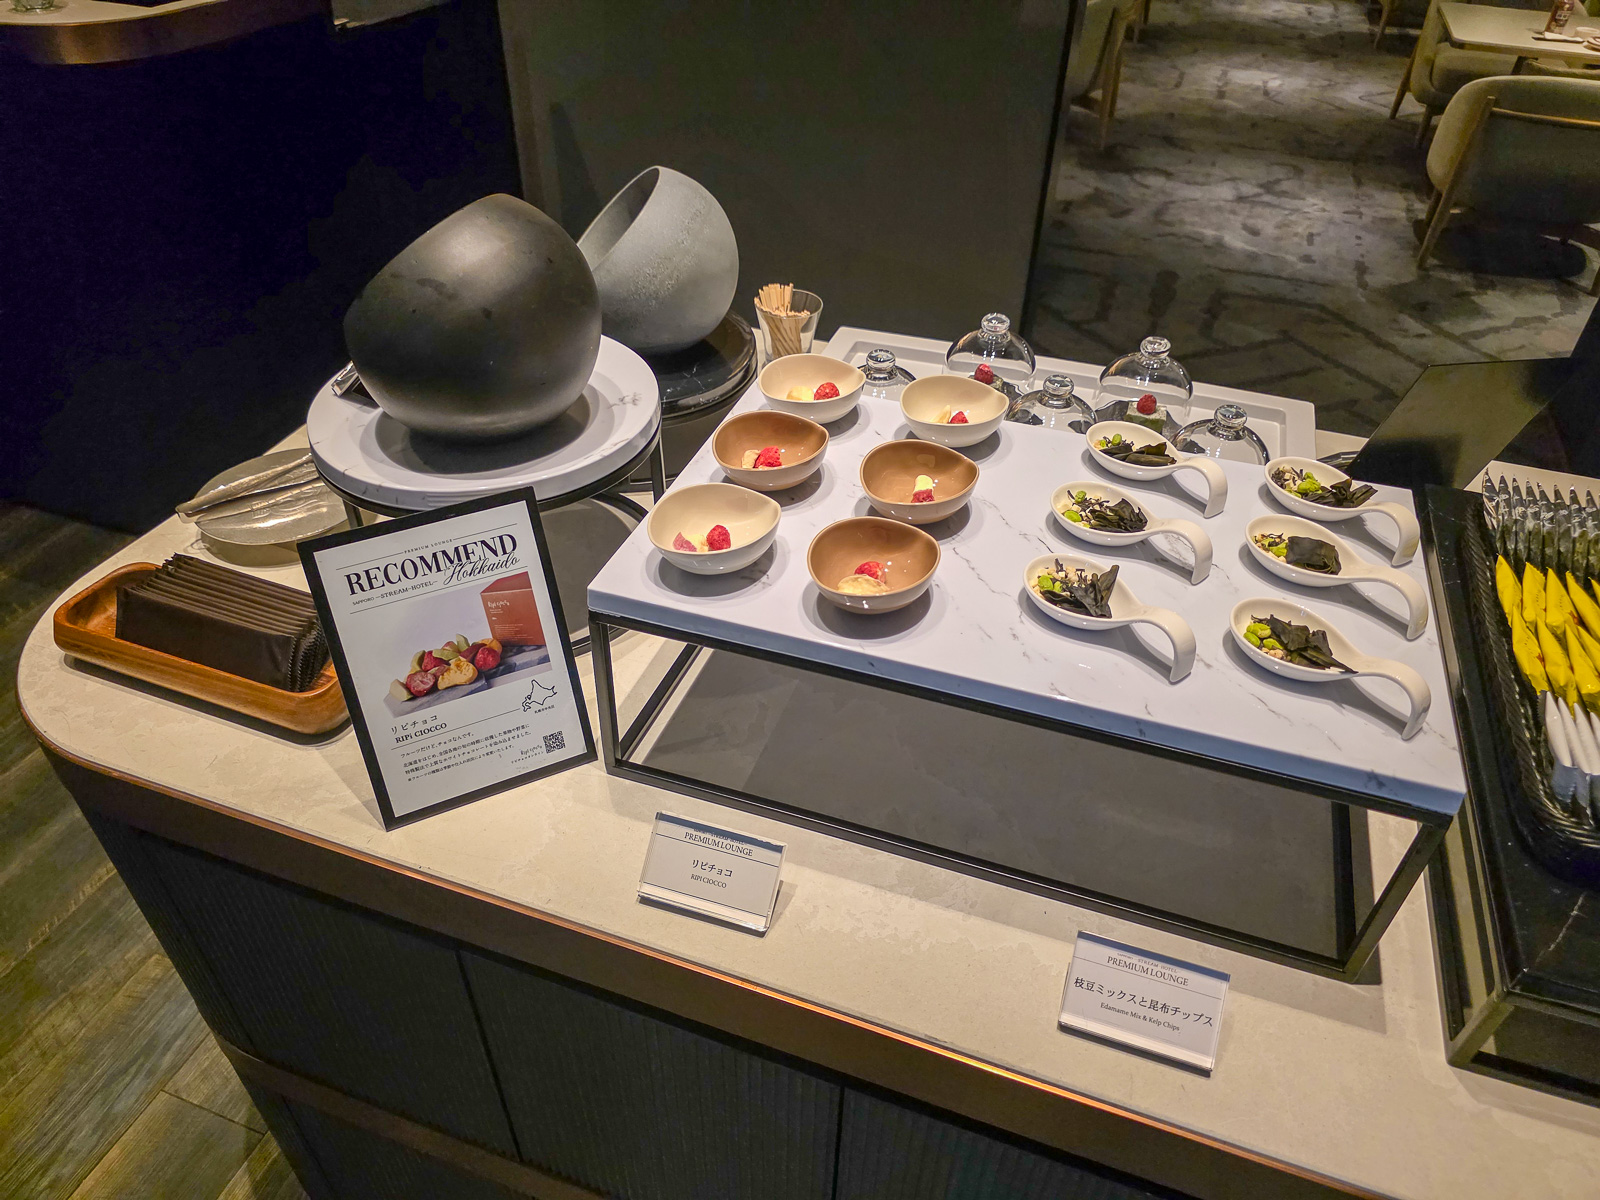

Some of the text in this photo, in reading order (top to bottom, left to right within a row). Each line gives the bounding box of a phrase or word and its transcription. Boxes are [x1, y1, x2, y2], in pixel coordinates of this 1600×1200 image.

[344, 533, 517, 596] RECOMMEND
[443, 552, 520, 586] Hokkaido
[352, 596, 375, 606] SAPPORO
[391, 714, 438, 735] リピチョコ
[395, 722, 448, 744] RIPi CIOCCO
[684, 831, 720, 847] PREMIUM
[720, 841, 753, 857] LOUNGE
[690, 873, 727, 889] RIPI CIOCCO
[692, 859, 733, 878] リピチョコ
[1107, 955, 1189, 986] PREMIUM LOUNGE
[1074, 976, 1213, 1027] 枝豆ミックスと昆布チップス
[1100, 1002, 1130, 1016] Edamame
[1129, 1011, 1142, 1020] Mix
[1148, 1016, 1162, 1027] Kelp
[1162, 1021, 1180, 1033] Chips
